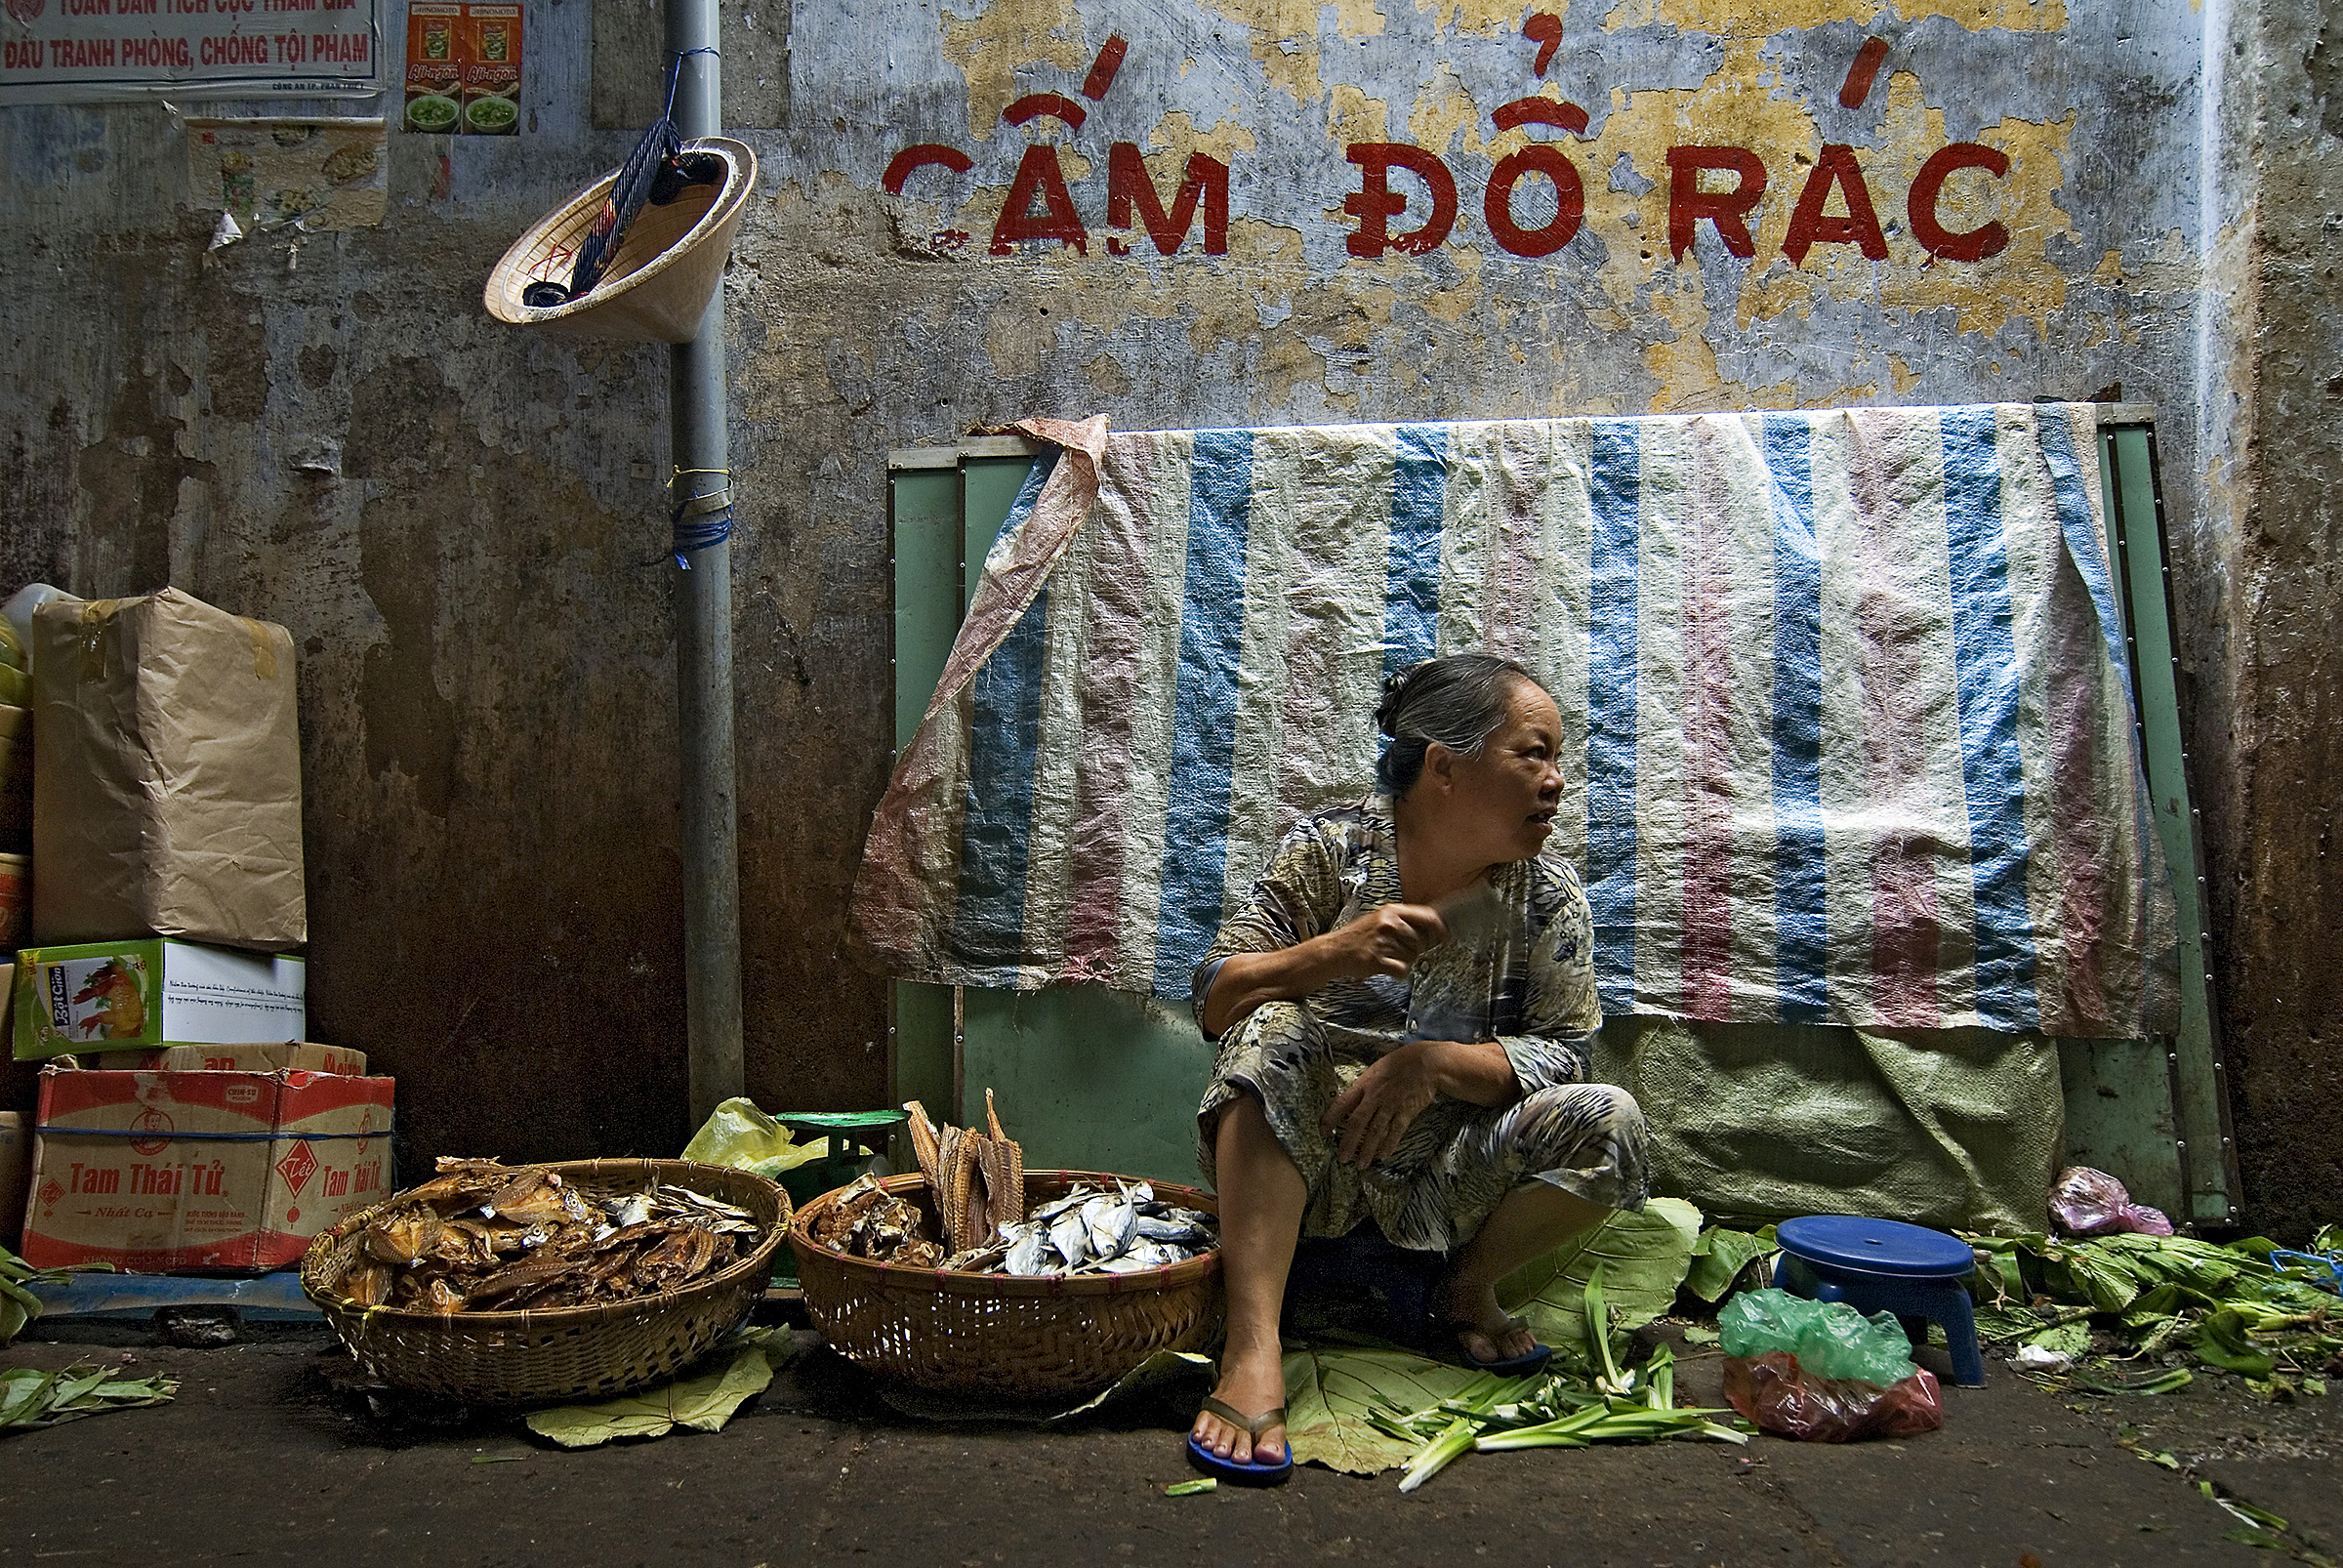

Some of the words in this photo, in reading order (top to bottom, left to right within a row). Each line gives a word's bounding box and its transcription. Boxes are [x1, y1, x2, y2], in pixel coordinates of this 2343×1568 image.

[50, 39, 115, 67] TRANH
[121, 30, 194, 71] PHÒNG,
[200, 23, 268, 65] CHỐNG
[274, 28, 307, 71] TỘI
[312, 33, 368, 71] PHẠM
[408, 63, 460, 81] Aji-ngon
[467, 65, 518, 83] Aji-ngon
[882, 33, 1229, 258] CẤM
[1344, 13, 1585, 257] ĐỔ
[1666, 36, 2012, 268] RÁC
[53, 995, 69, 1024] Bột
[70, 1162, 120, 1194] Tam
[130, 1162, 185, 1195] Thái
[192, 1160, 226, 1196] Tử
[283, 1157, 311, 1178] Tết
[322, 1165, 349, 1197] Tam
[95, 1207, 130, 1217] Nhất
[135, 1208, 153, 1218] Ca
